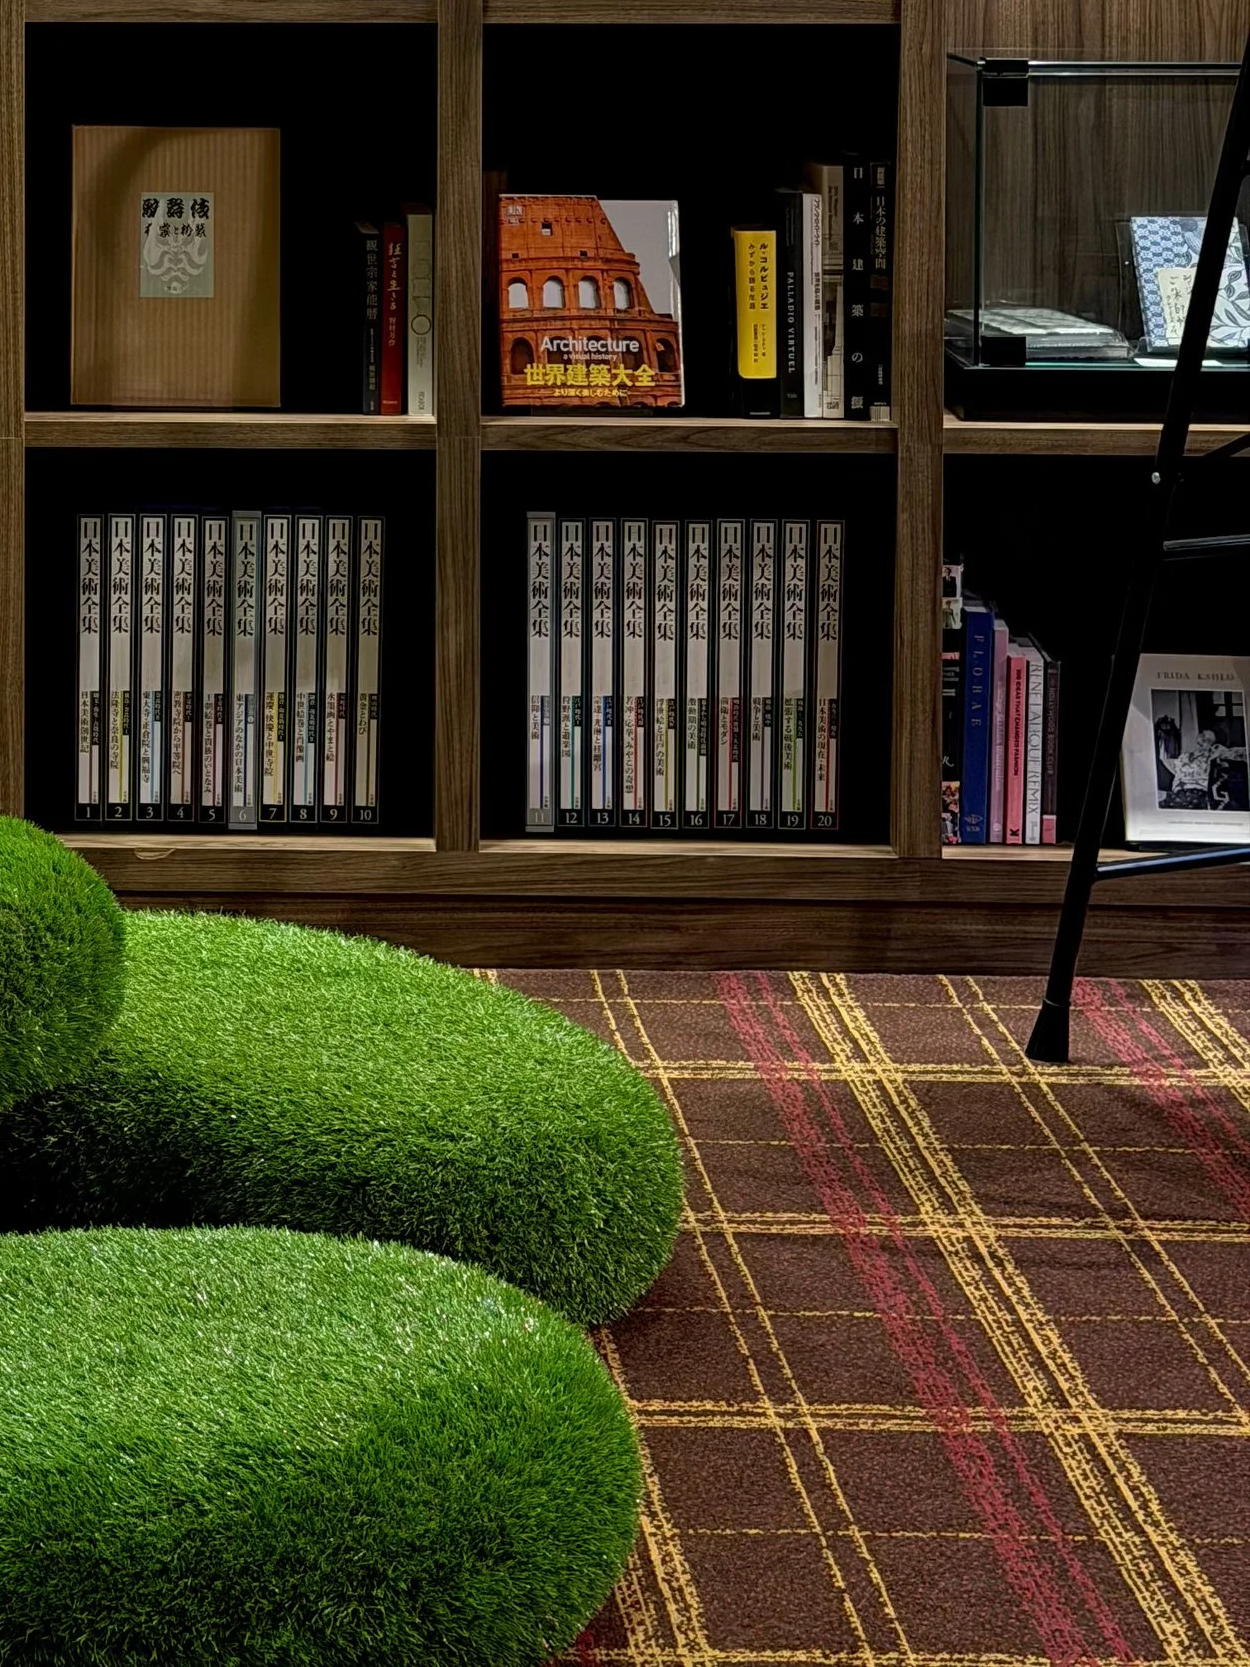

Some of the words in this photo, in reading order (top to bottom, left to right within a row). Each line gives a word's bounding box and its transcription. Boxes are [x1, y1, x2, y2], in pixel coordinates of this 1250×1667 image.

[786, 272, 795, 323] PALLADIO
[541, 336, 639, 352] Architecture
[591, 353, 617, 361] history
[787, 327, 796, 373] VIRTUEL
[524, 363, 656, 387] 世界建築大全
[81, 521, 99, 634] 日本美術全集
[112, 521, 130, 634] 日本美術全集
[143, 521, 161, 634] 日本美術全集
[174, 521, 192, 634] 日本美術全集
[205, 523, 223, 636] 日本美術全集
[236, 524, 255, 636] 日本美術全集
[268, 522, 286, 635] 日本美術全集
[299, 522, 317, 635] 日本美術全集
[328, 522, 348, 636] 日本美術全集
[361, 522, 380, 636] 日本美術全集
[531, 525, 550, 638] 日本美術全集
[563, 525, 581, 638] 日本美術全集
[594, 525, 611, 638] 日本美術全集
[625, 525, 644, 638] 日本美術全集
[657, 526, 674, 641] 日本美術全集
[689, 525, 707, 640] 日本美術全集
[721, 525, 739, 640] 日本美術全集
[754, 525, 772, 639] 日本美術全集
[785, 526, 803, 641] 日本美術全集
[820, 526, 838, 641] 日本美術全集
[86, 807, 90, 818] 1
[115, 806, 122, 817] 2
[146, 806, 153, 818] 3
[177, 806, 184, 818] 4
[209, 809, 215, 821] 5
[239, 809, 246, 821] 6
[269, 808, 277, 819] 7
[300, 808, 307, 820] 8
[330, 809, 338, 820] 9
[360, 809, 372, 820] 10
[1028, 771, 1039, 815] REMIX
[565, 812, 577, 824] 12
[597, 812, 609, 824] 13
[628, 813, 640, 824] 14
[659, 815, 671, 826] 15
[690, 814, 703, 825] 16
[723, 814, 735, 825] 17
[755, 814, 767, 824] 18
[787, 815, 799, 826] 19
[818, 815, 832, 826] 20
